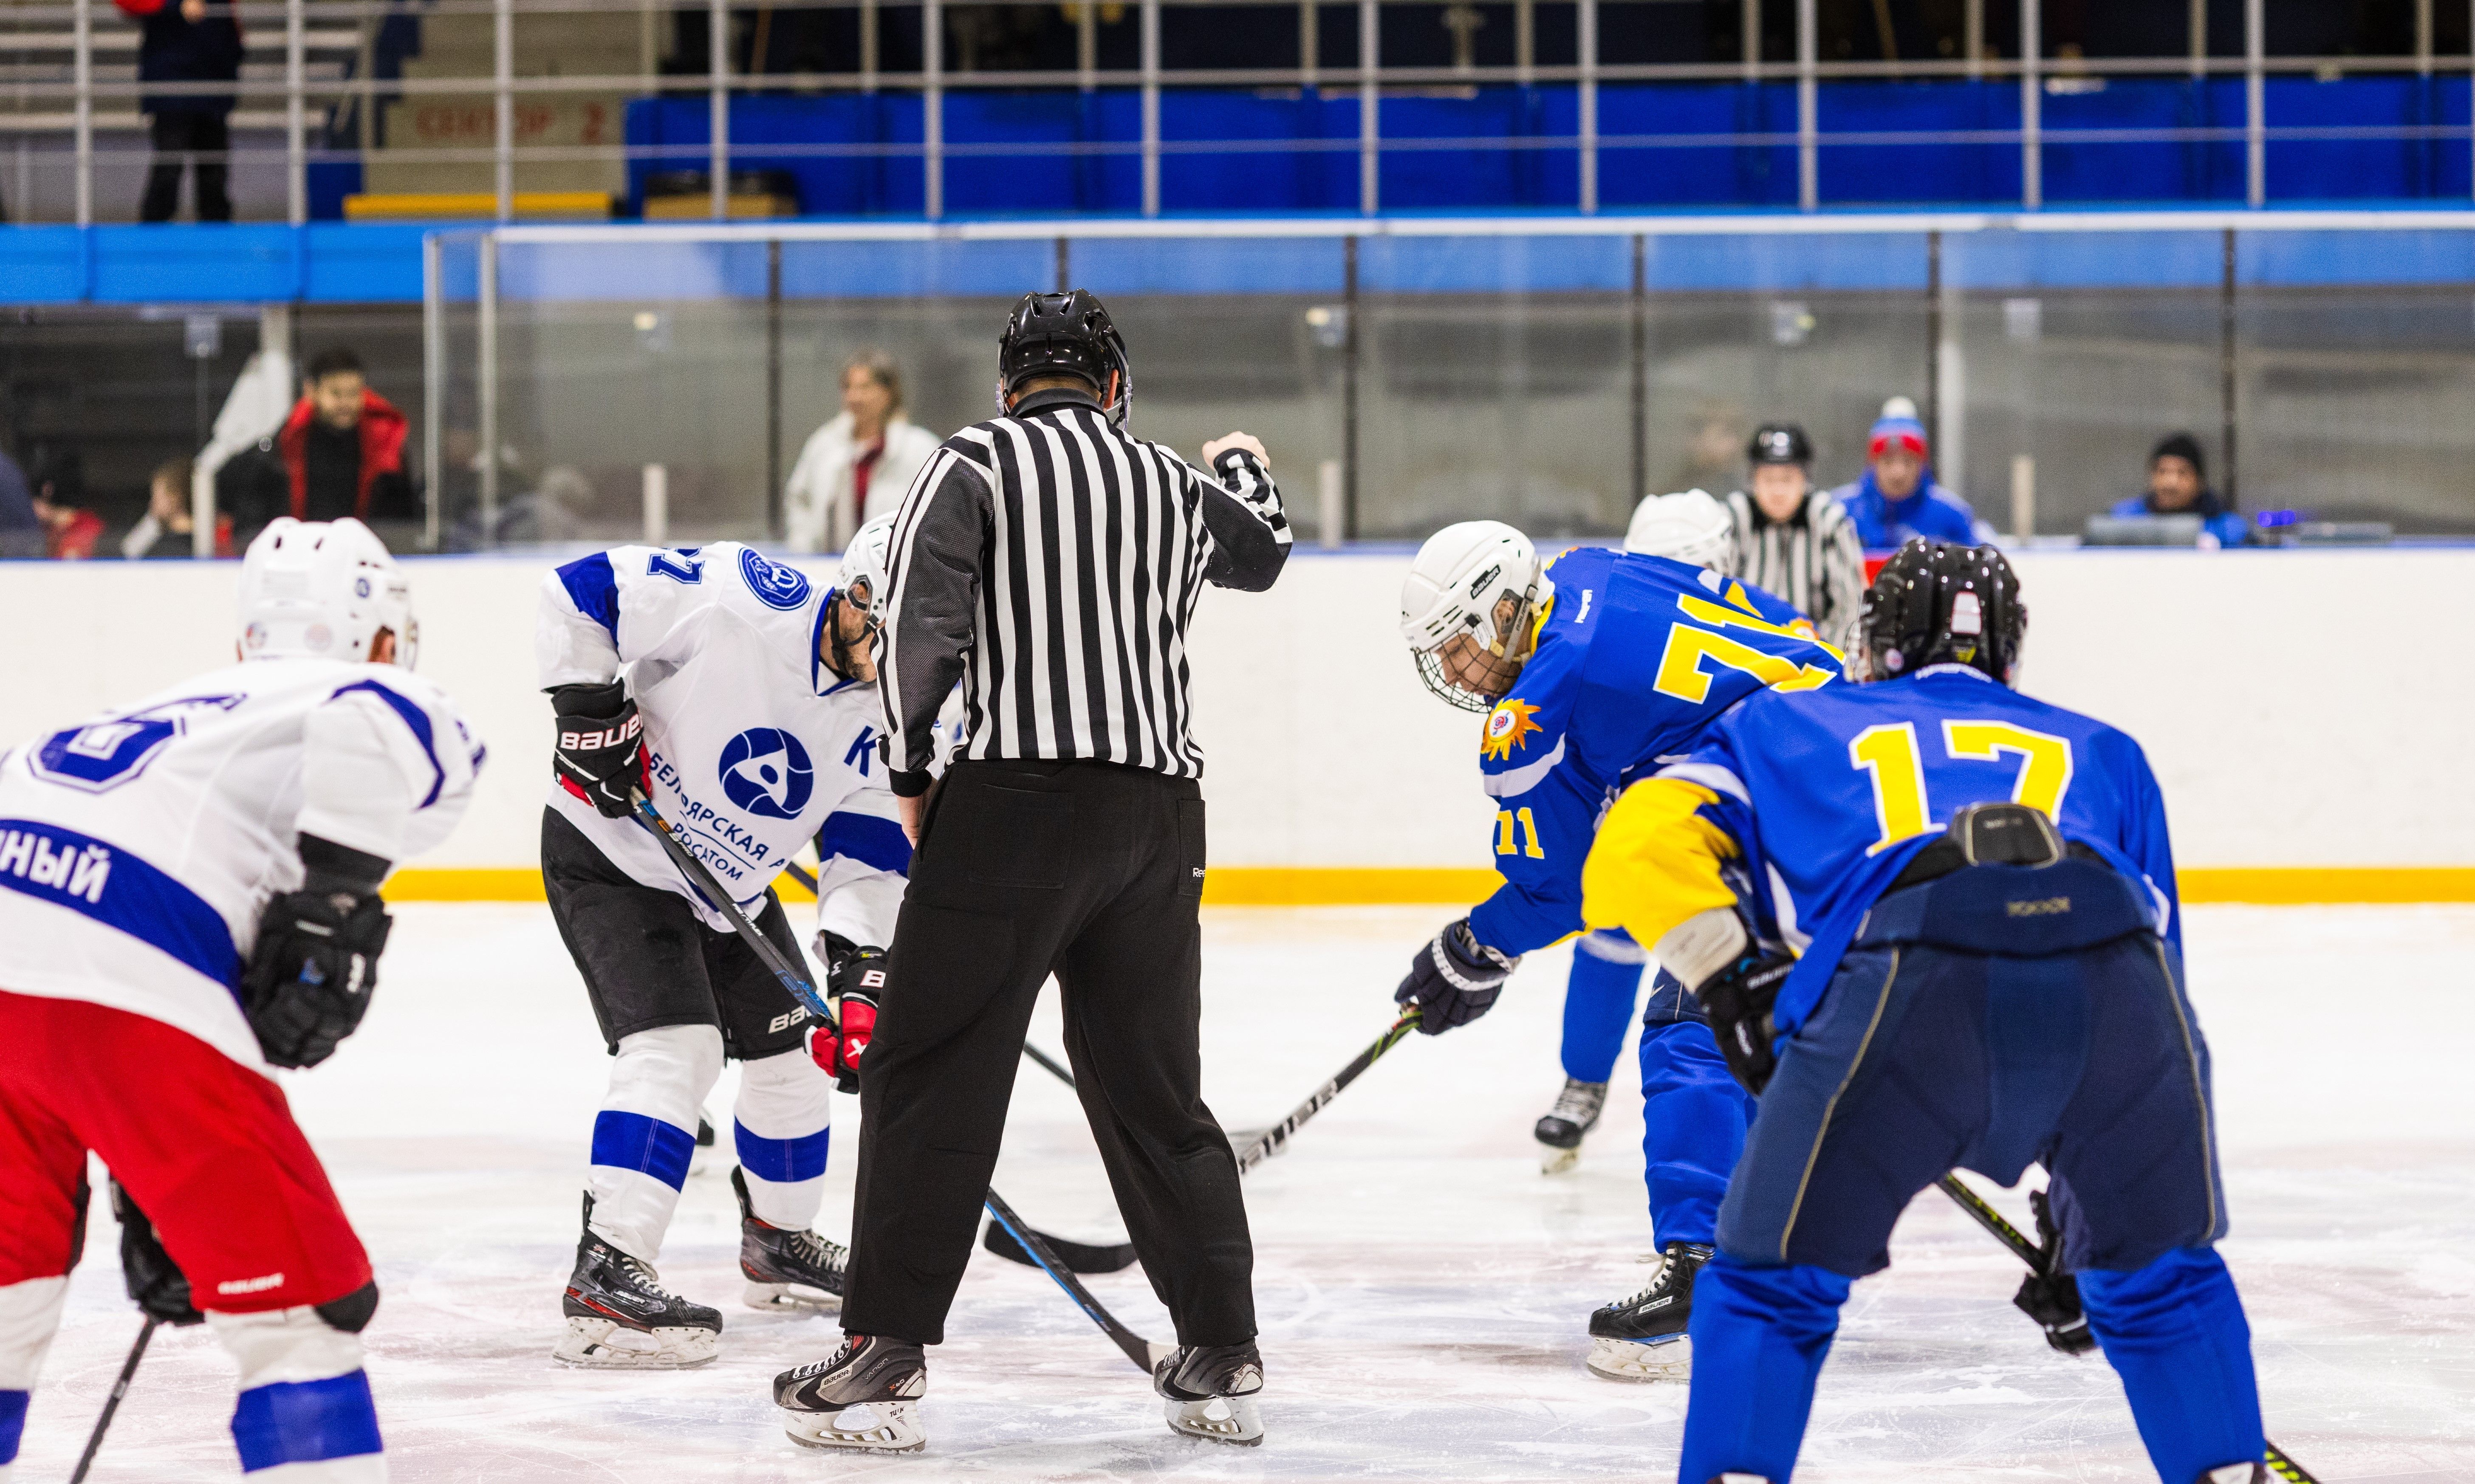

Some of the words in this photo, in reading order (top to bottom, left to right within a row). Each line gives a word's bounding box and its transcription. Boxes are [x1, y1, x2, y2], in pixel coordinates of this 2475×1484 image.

[1848, 718, 2073, 857] 17
[672, 823, 743, 880] РОСАТОМ
[1496, 807, 1544, 859] 71
[0, 829, 112, 904] НЫЙ
